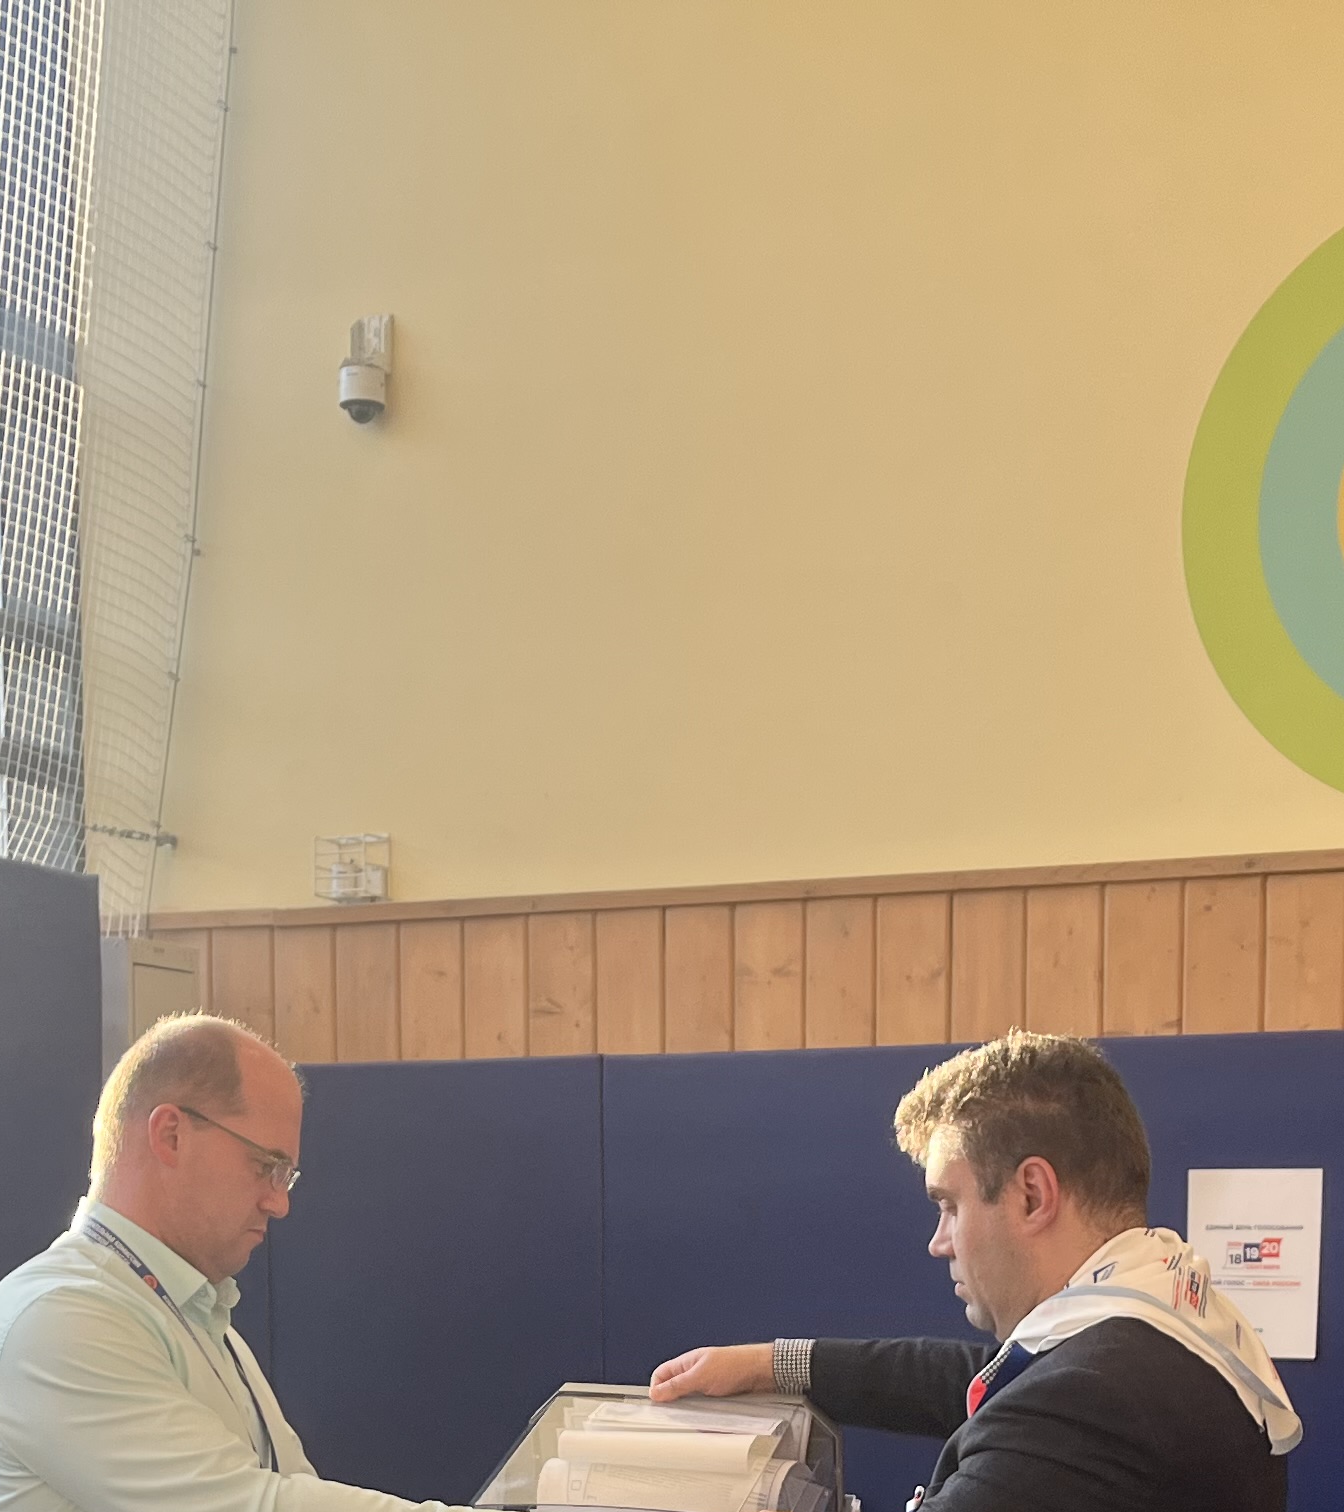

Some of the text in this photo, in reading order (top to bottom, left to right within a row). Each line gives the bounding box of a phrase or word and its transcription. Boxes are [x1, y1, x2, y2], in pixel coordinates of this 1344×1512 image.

[1244, 1246, 1260, 1260] 19
[1261, 1241, 1279, 1254] 20
[1228, 1253, 1242, 1264] 18
